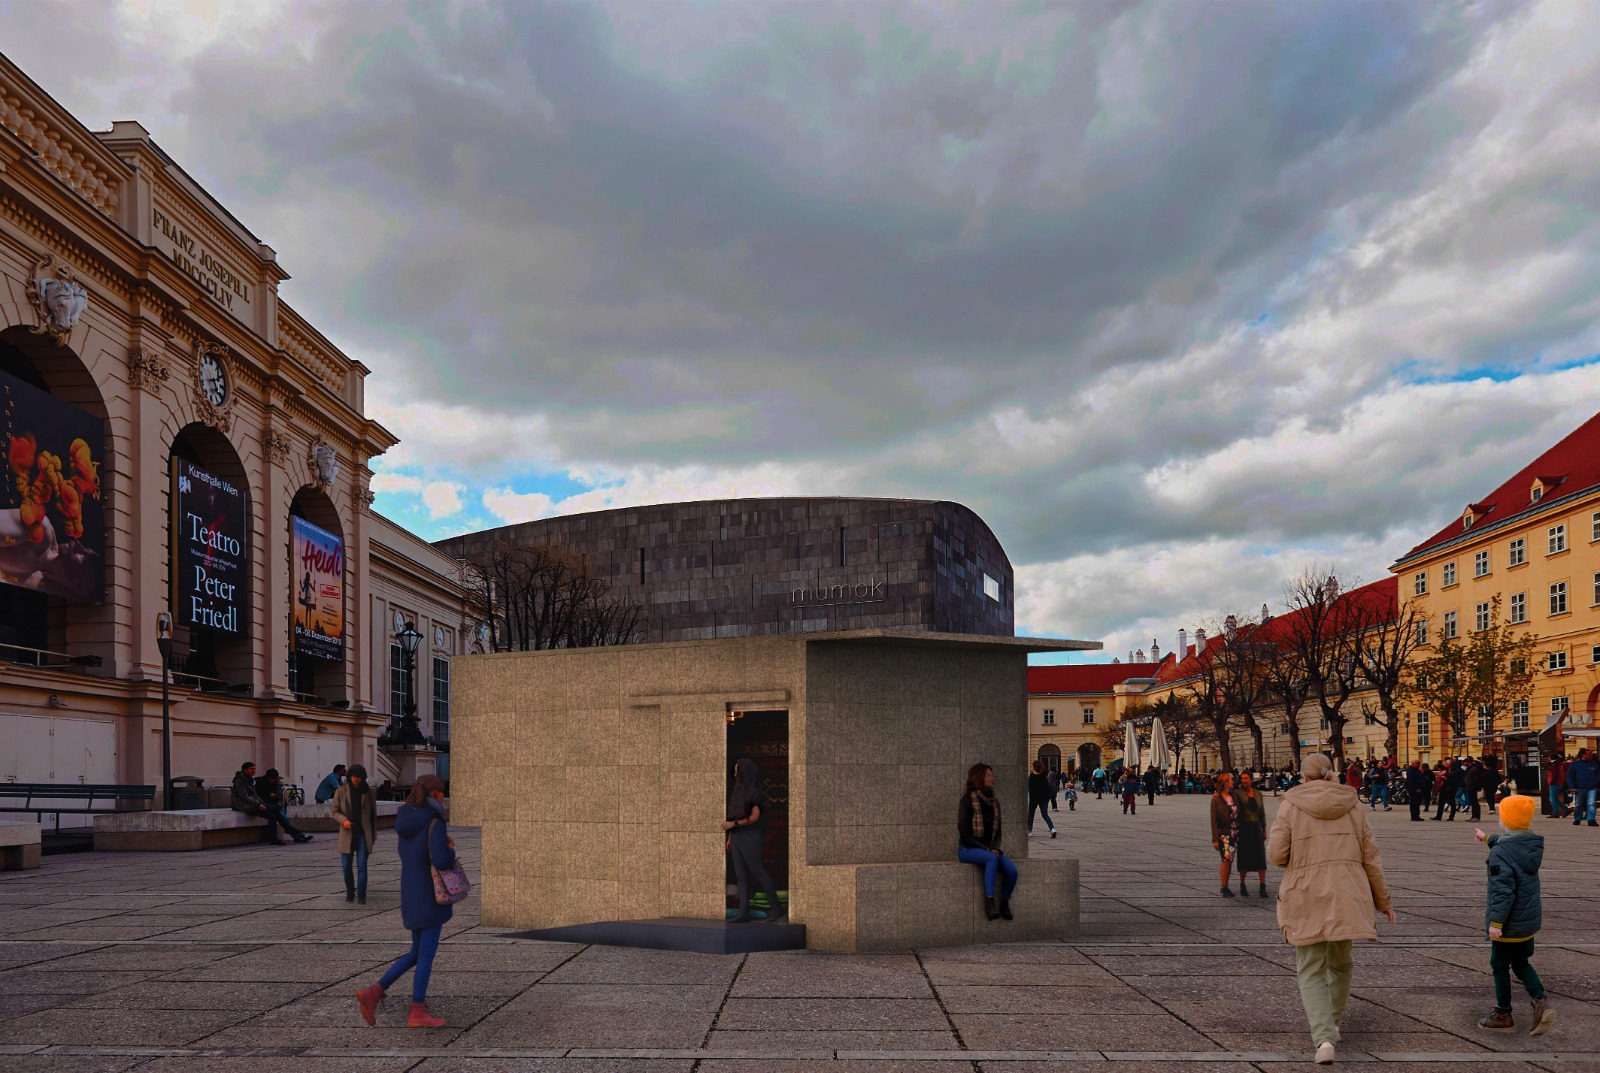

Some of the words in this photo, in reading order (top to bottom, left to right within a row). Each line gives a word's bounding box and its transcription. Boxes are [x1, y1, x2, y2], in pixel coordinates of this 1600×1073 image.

[153, 208, 196, 259] FRANZ
[1, 385, 15, 515] Tanzquartie
[188, 464, 222, 488] Kunsthalle
[222, 481, 238, 497] Wien
[187, 512, 240, 556] Teatro
[302, 540, 342, 577] Heidi
[194, 565, 235, 600] Peter
[792, 577, 884, 602] mumok
[190, 595, 238, 632] Friedl
[311, 630, 333, 643] Dezember
